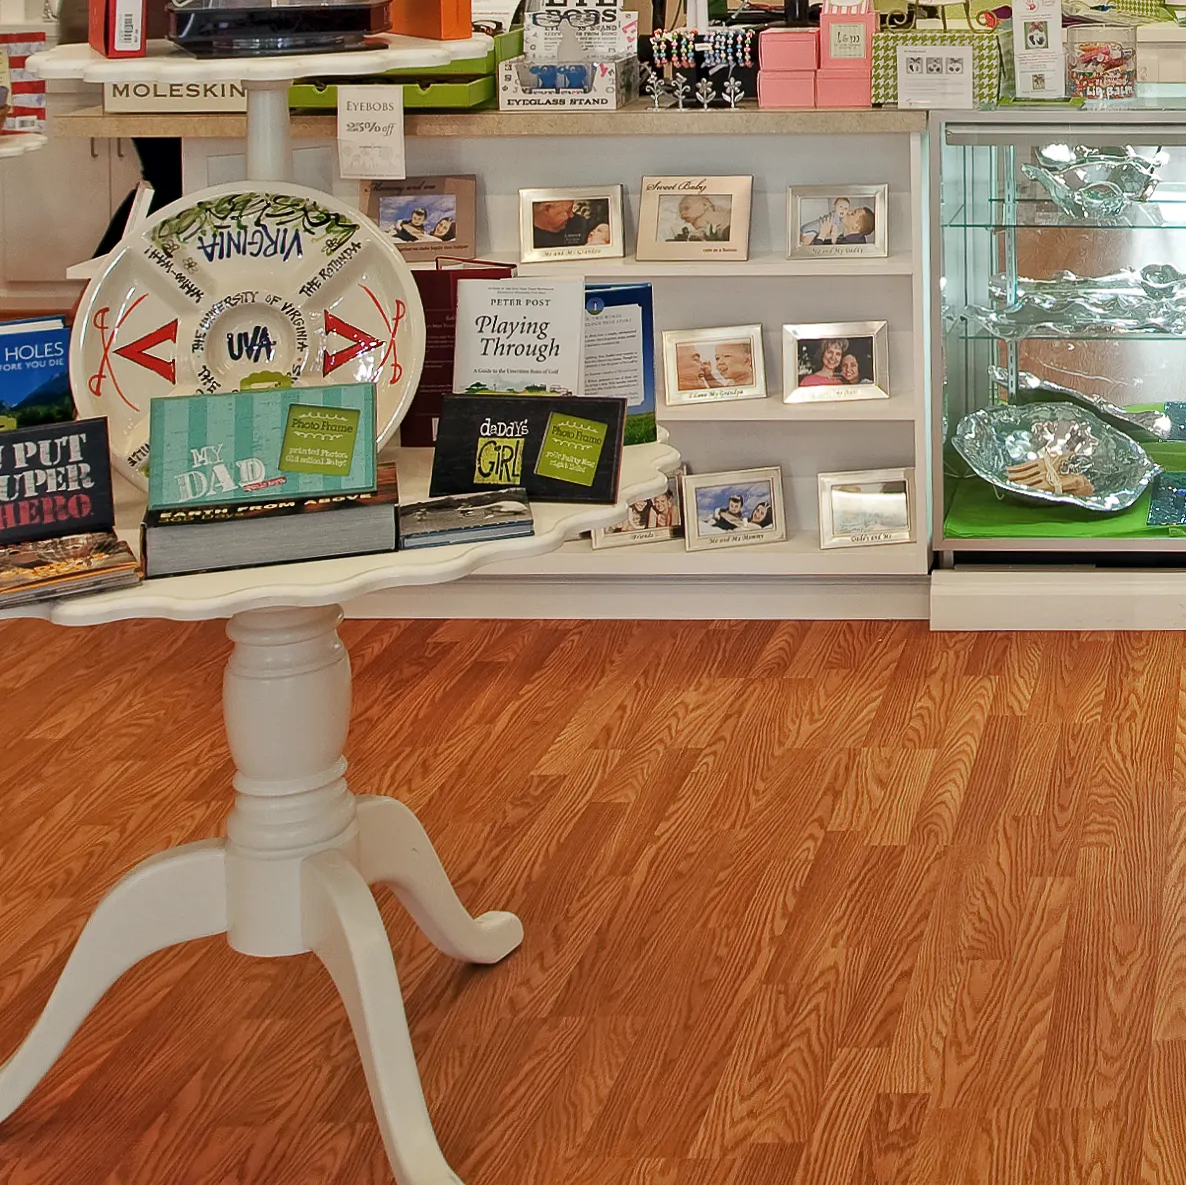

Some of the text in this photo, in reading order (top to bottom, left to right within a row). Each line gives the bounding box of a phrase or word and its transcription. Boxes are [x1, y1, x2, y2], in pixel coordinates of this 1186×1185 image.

[112, 83, 246, 98] MOLESKIN
[346, 100, 394, 112] EYEBOBS
[507, 98, 566, 106] EYEGLASS
[346, 122, 397, 136] 25% off
[646, 178, 708, 194] Sweet Baby
[198, 228, 304, 262] VIRGINIA
[299, 241, 362, 298] THE ROTUNDA
[490, 298, 551, 307] PETER POST
[191, 290, 309, 354] THE UNIVERSITY OF VIRGINIA
[475, 315, 550, 341] Playing
[5, 342, 64, 361] HOLES
[226, 325, 277, 363] UVA
[480, 337, 561, 363] Through
[25, 360, 45, 370] YOU
[48, 358, 64, 366] DIE
[291, 418, 354, 433] Photo Frame
[552, 425, 575, 439] Photo
[13, 433, 87, 469] PUT
[191, 442, 224, 469] MY
[173, 457, 267, 503] DAD
[159, 492, 373, 519] EARTH FROM ABOVE
